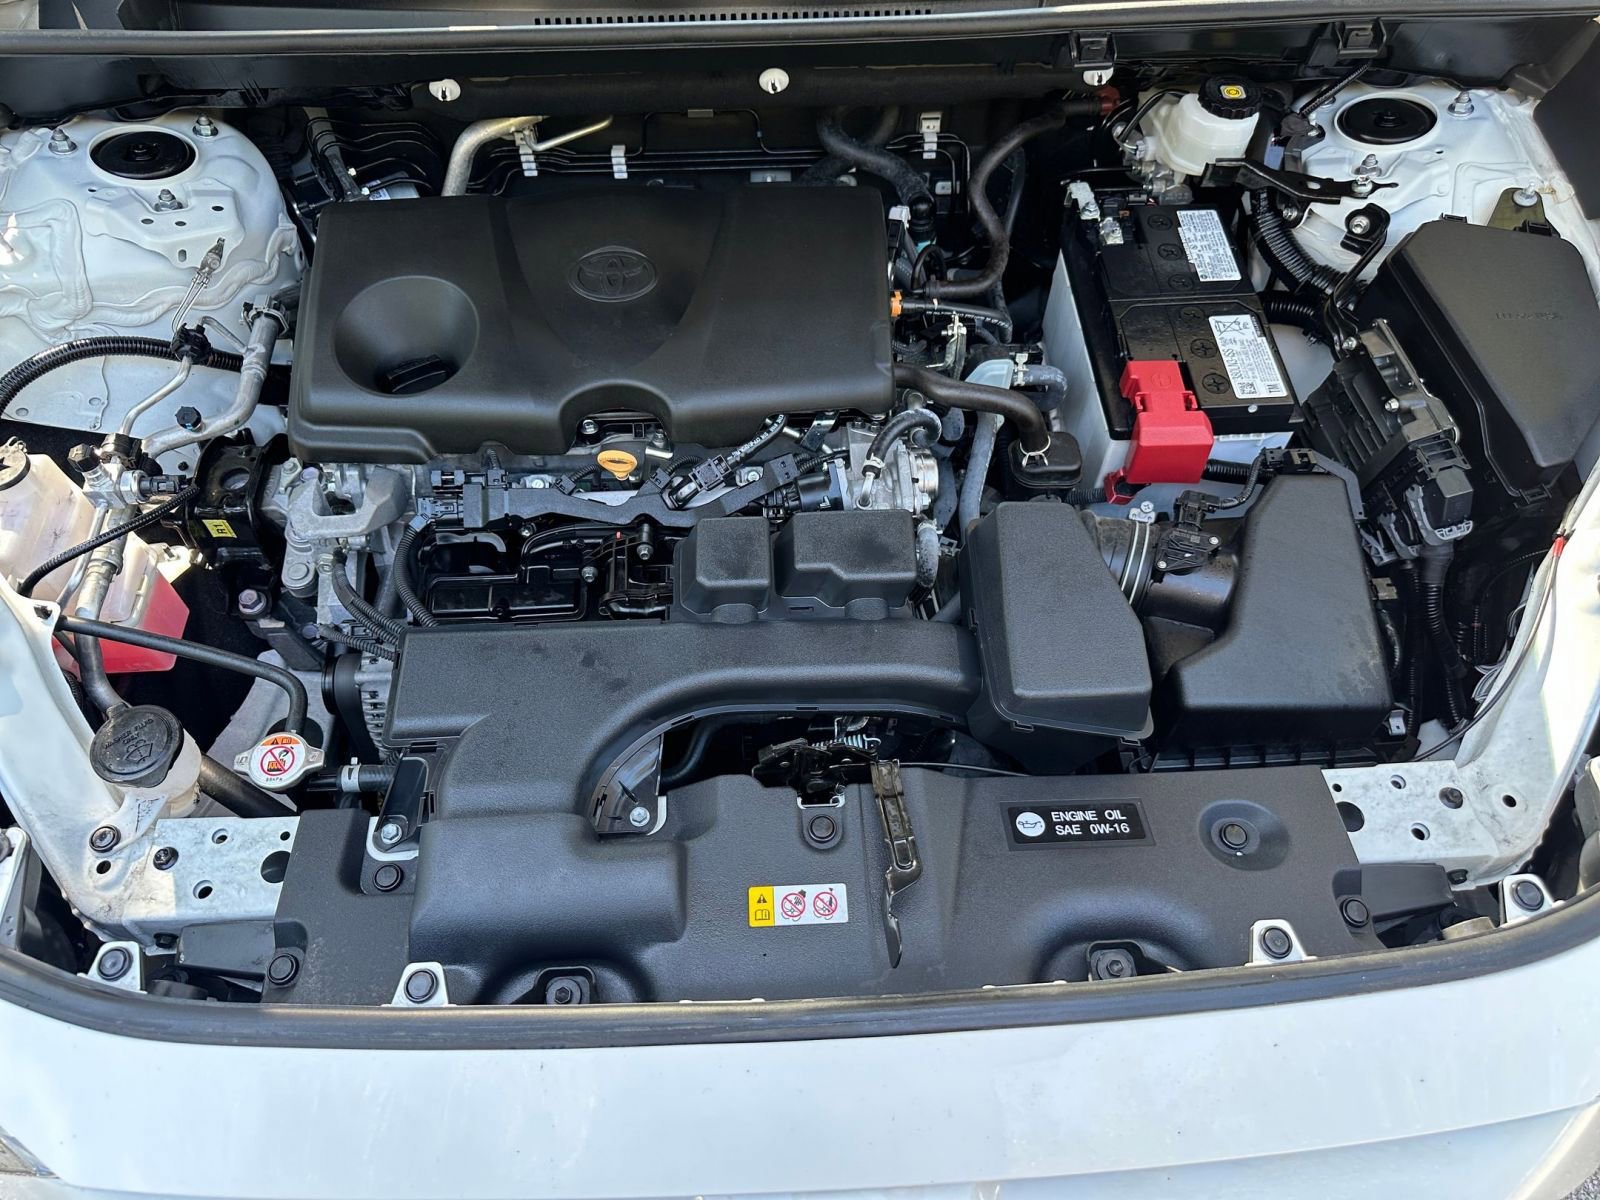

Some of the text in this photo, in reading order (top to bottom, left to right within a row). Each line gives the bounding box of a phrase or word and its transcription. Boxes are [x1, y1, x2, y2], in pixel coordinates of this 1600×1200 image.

[1051, 810, 1126, 822] ENGINE OIL
[1055, 823, 1130, 836] SAE 0W-16
